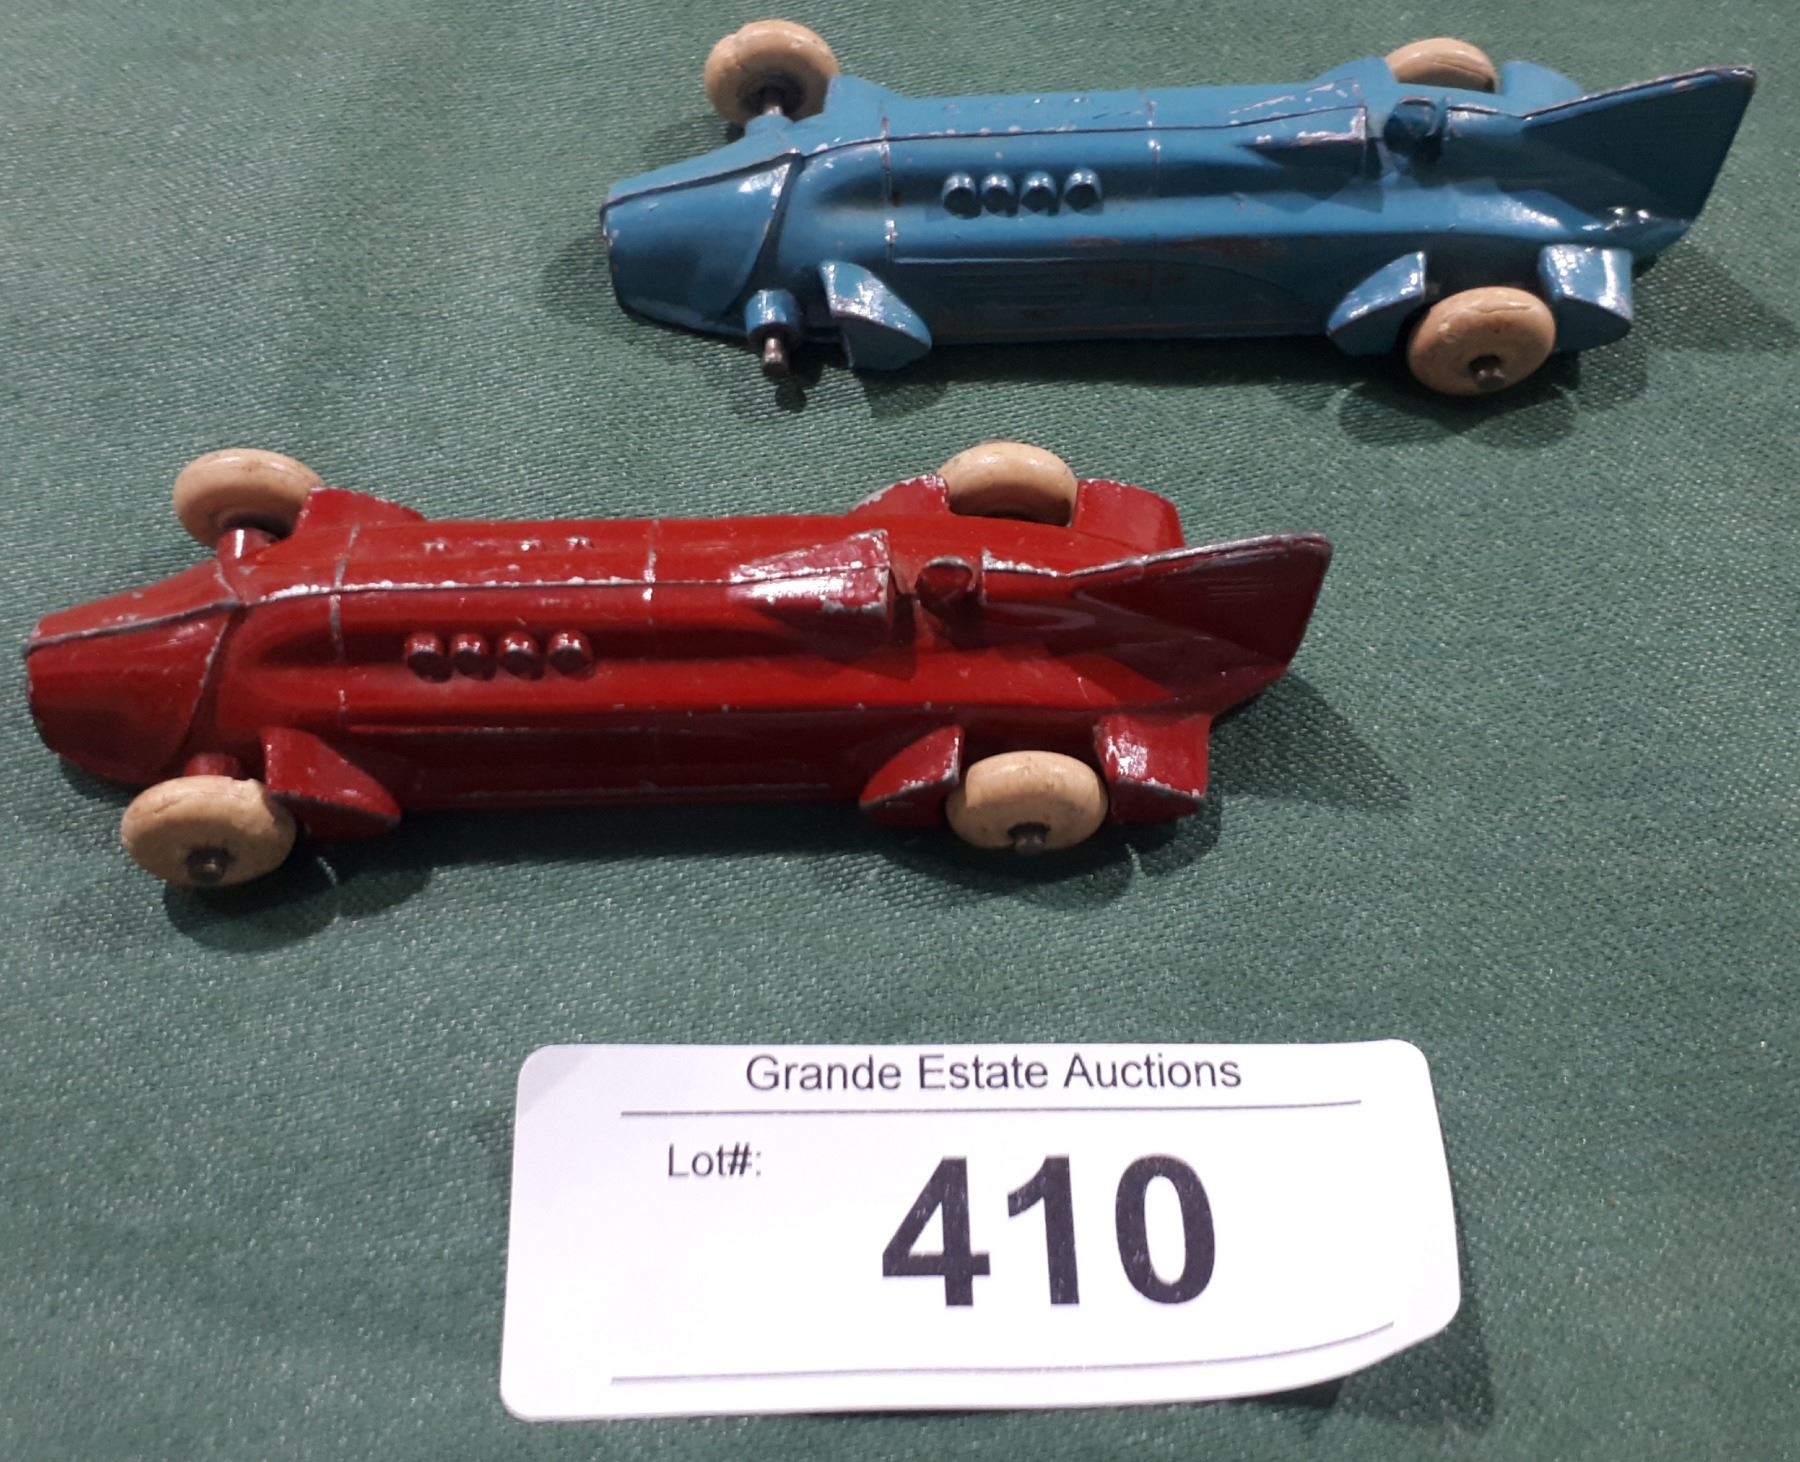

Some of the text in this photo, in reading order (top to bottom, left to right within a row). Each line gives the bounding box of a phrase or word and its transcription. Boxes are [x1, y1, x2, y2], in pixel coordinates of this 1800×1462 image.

[746, 1054, 1242, 1090] Grande Estate Auctions
[667, 1143, 762, 1178] Lot#:
[882, 1155, 1217, 1307] 410
